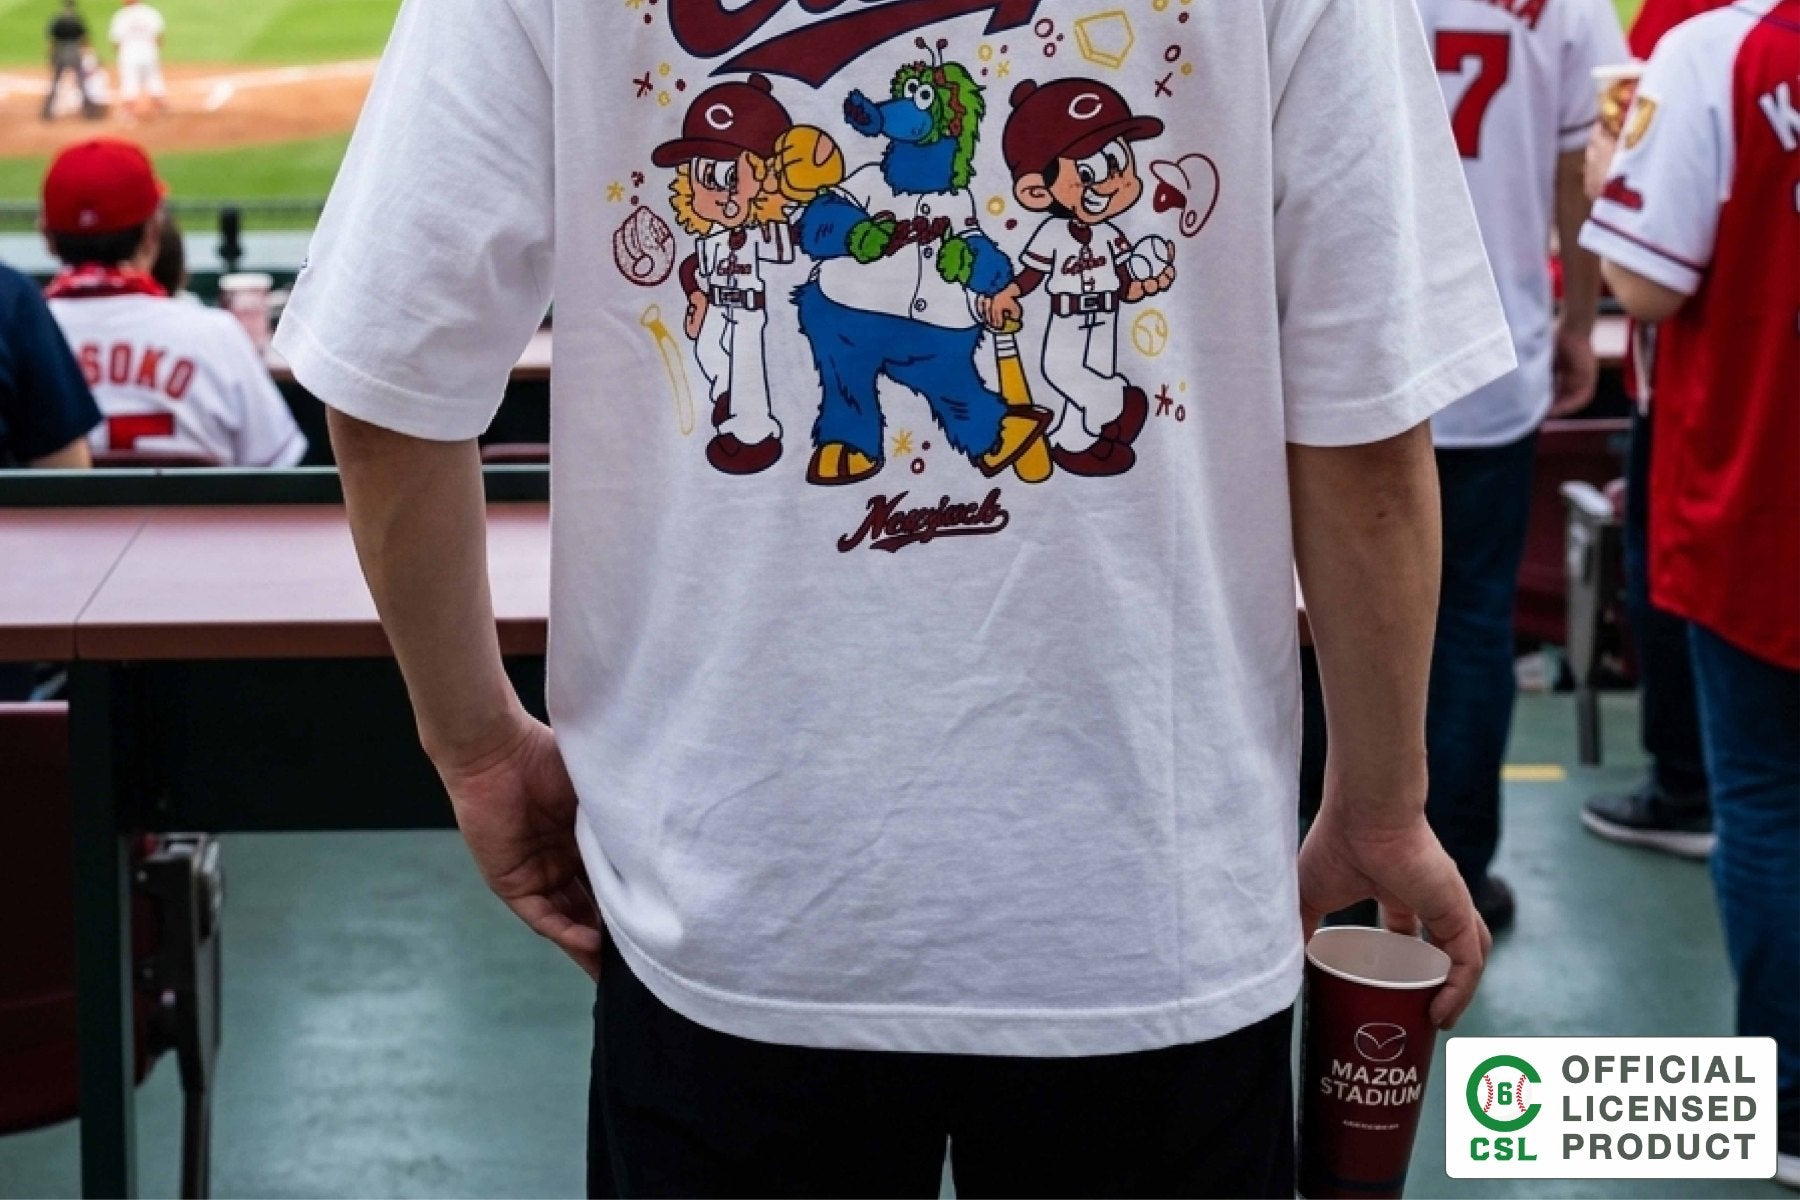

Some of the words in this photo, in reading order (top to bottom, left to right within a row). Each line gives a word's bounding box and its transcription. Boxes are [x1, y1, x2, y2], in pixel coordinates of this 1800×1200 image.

[1069, 93, 1102, 120] C
[1435, 29, 1510, 159] 7
[705, 103, 734, 130] C
[78, 341, 194, 400] SOKO
[1331, 1058, 1417, 1086] MAZDA
[1321, 1076, 1422, 1106] STADIUM
